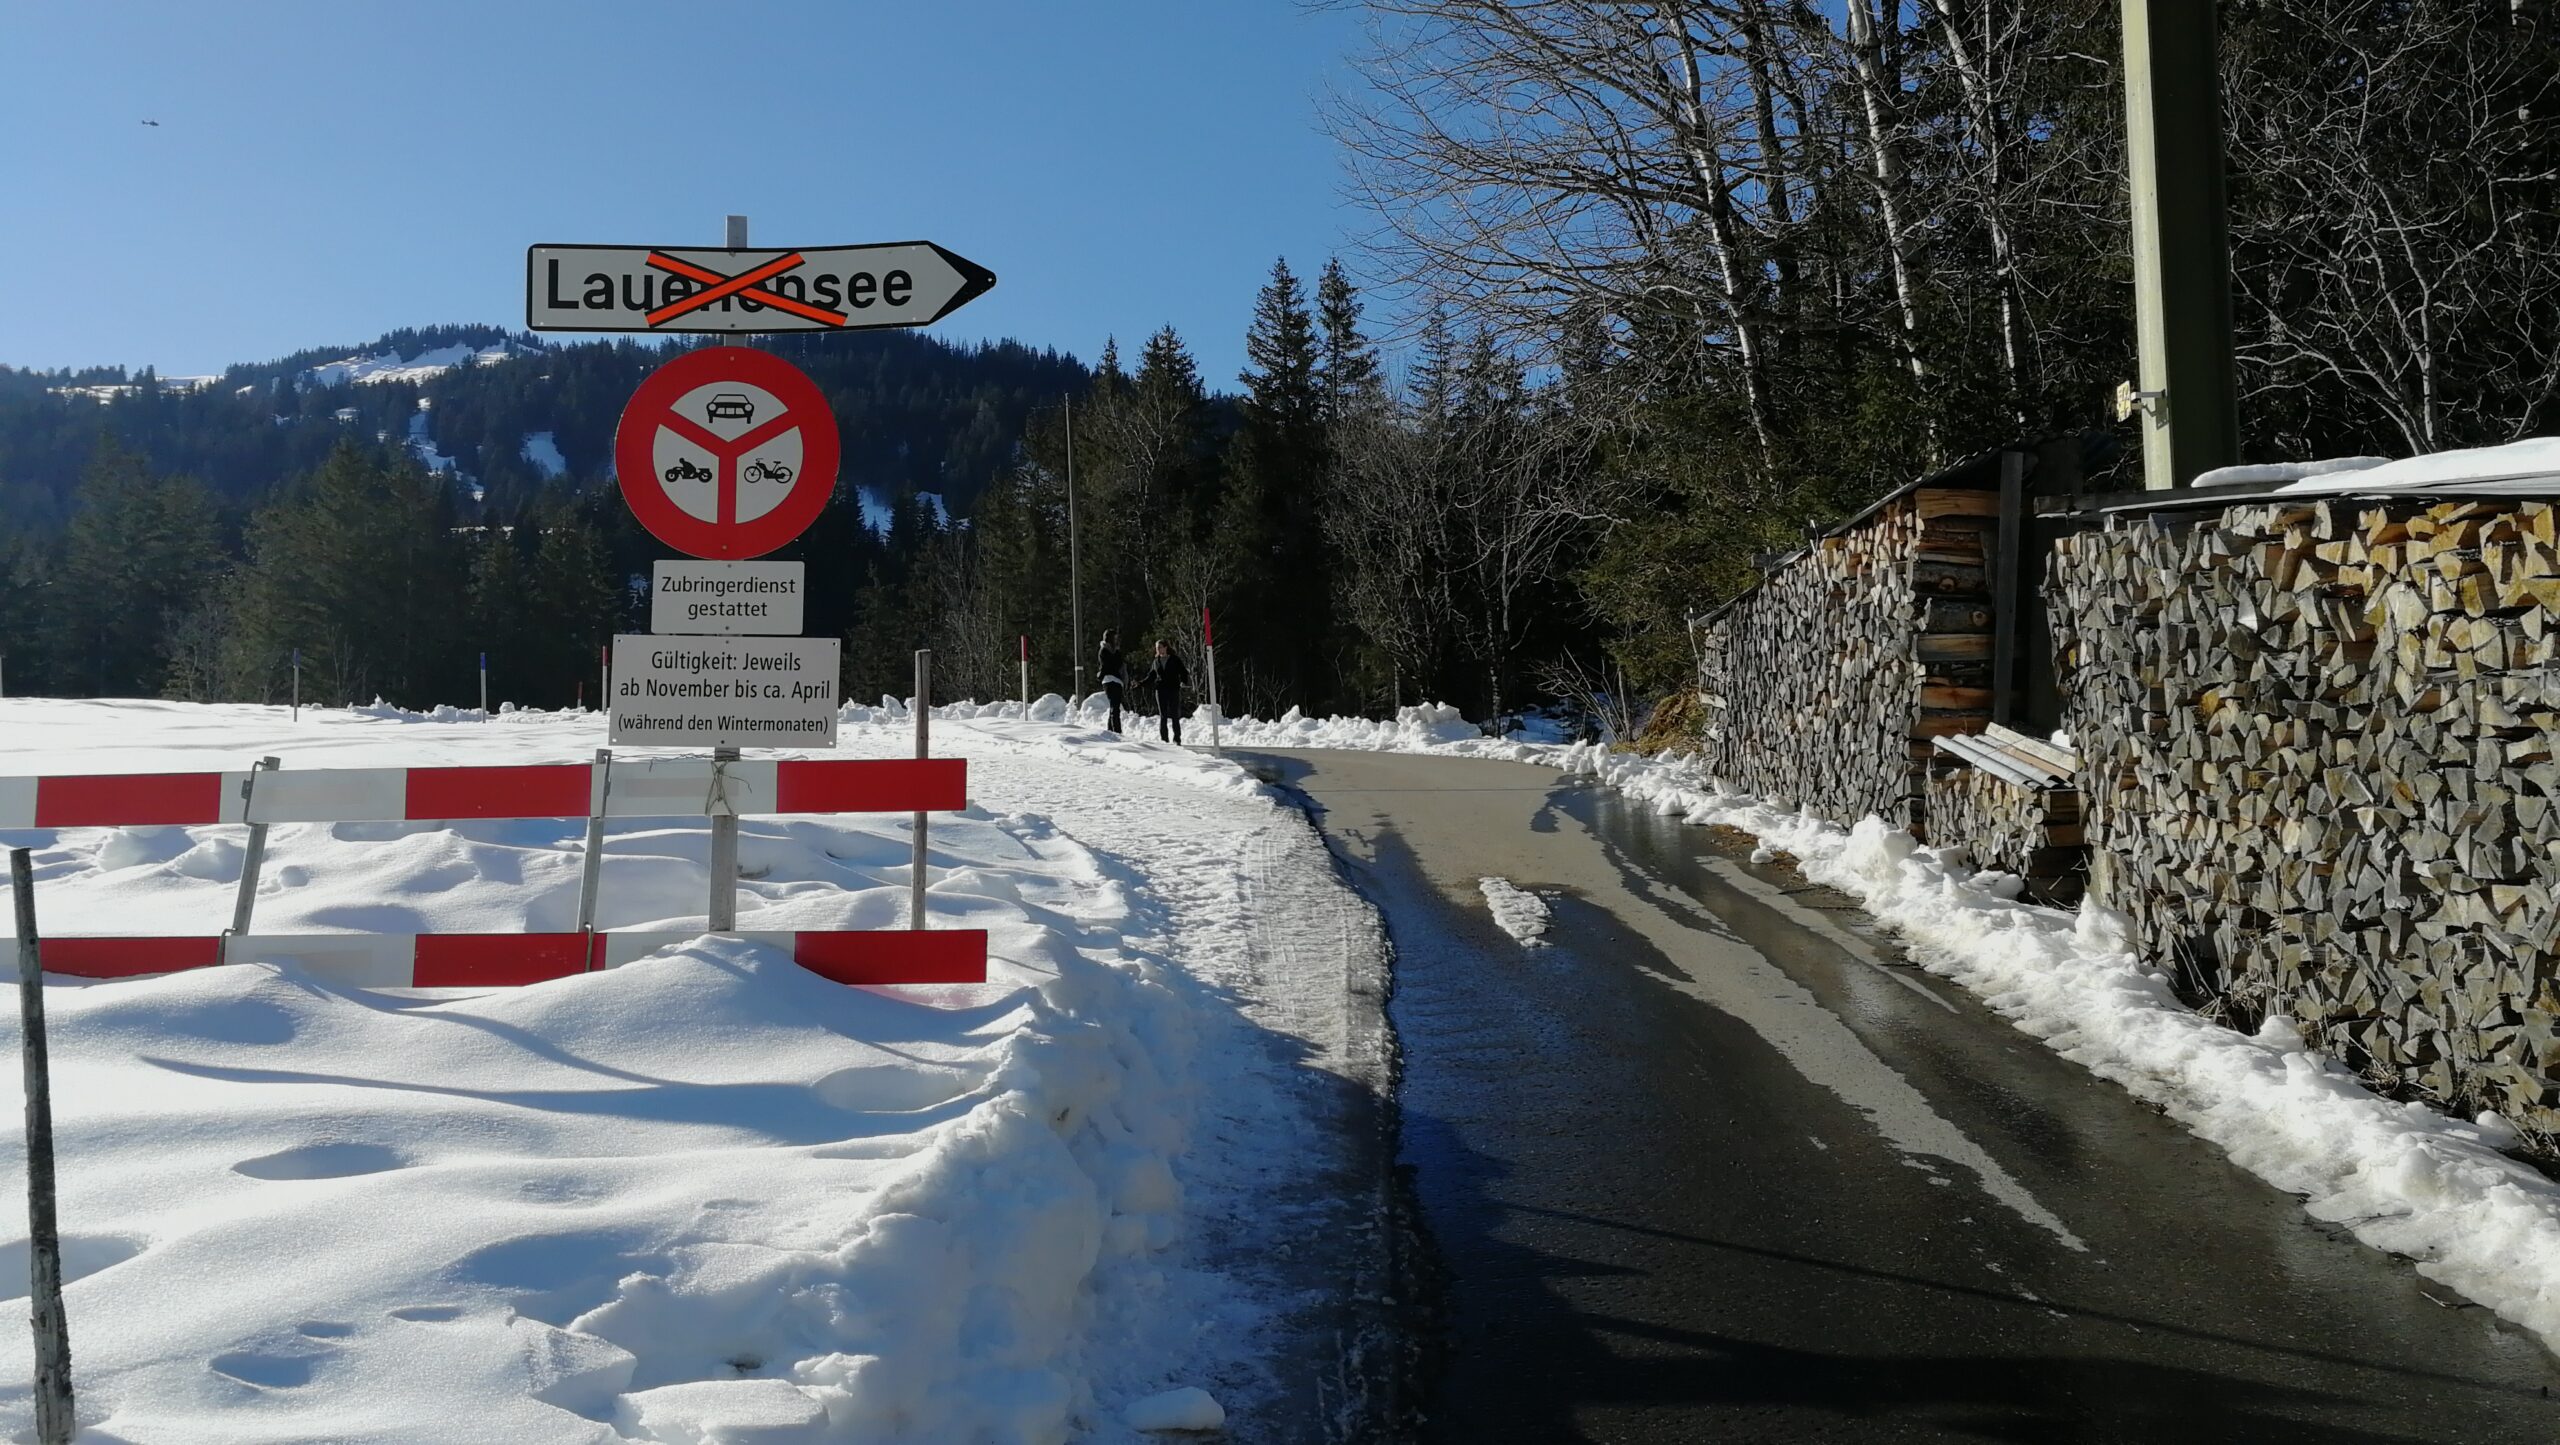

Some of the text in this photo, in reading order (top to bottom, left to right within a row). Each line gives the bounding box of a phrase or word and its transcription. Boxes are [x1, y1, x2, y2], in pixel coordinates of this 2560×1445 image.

[661, 576, 796, 597] Zubringerdienst
[688, 601, 768, 620] gestattet
[651, 651, 801, 674] Gültigkeit: Jeweils
[620, 677, 831, 704] ab November bis ca. April
[618, 713, 828, 735] (während den Wintermonaten)
